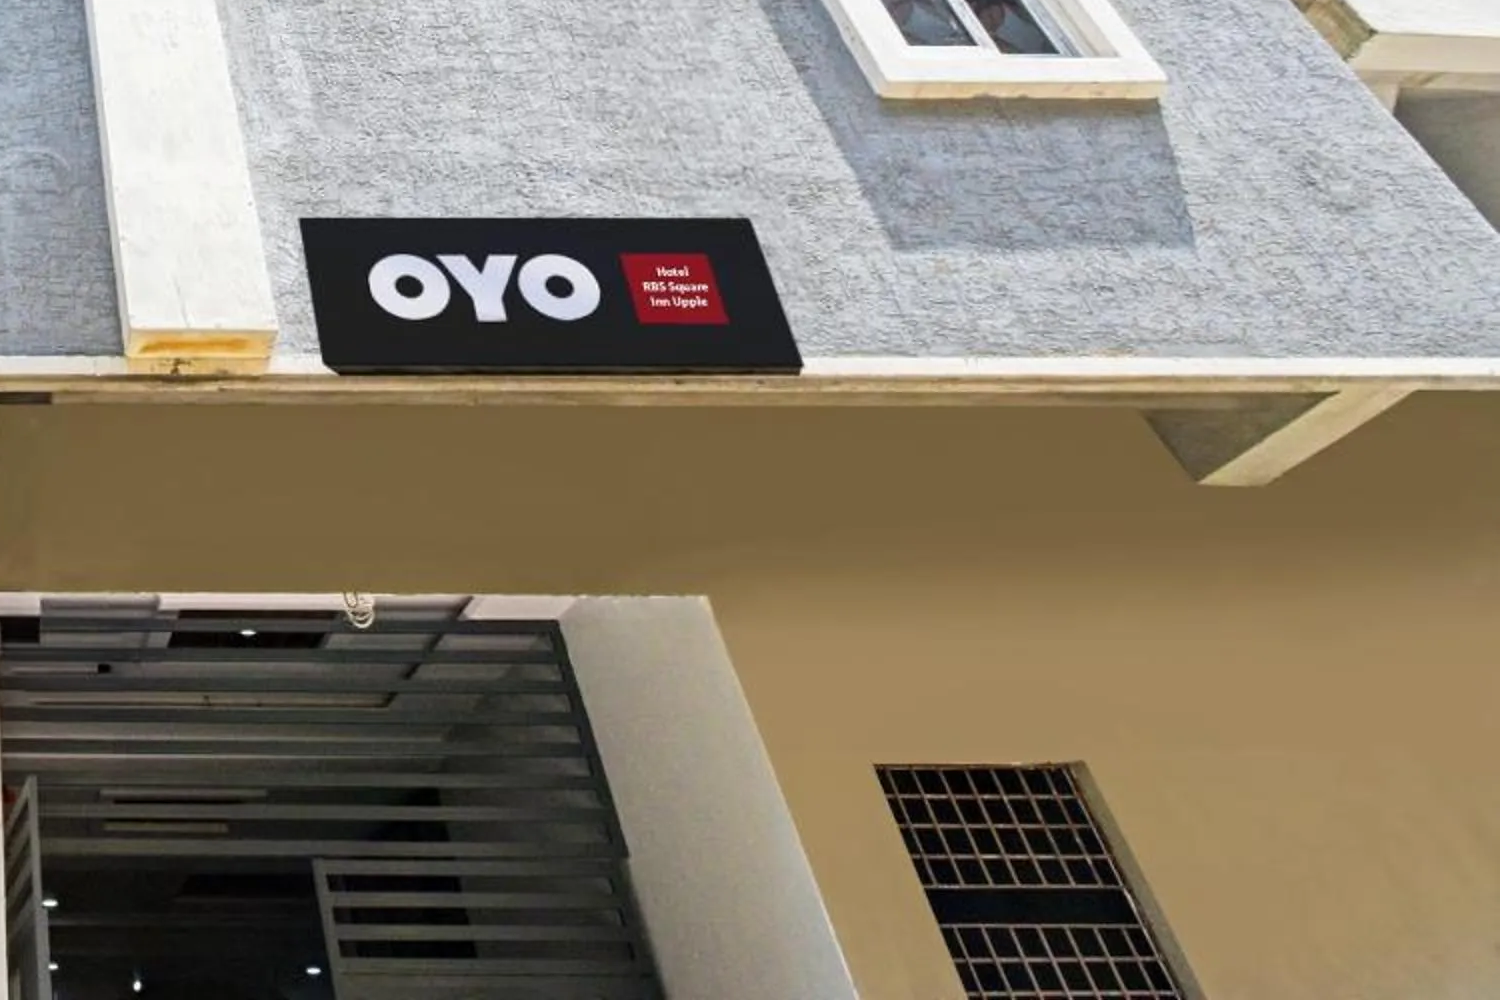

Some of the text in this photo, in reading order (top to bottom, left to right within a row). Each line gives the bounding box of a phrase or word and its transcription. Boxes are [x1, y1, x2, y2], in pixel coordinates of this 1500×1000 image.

[656, 266, 690, 277] Hotel
[368, 253, 601, 322] OYO
[668, 281, 709, 294] Square
[650, 296, 708, 309] Inn Upple
